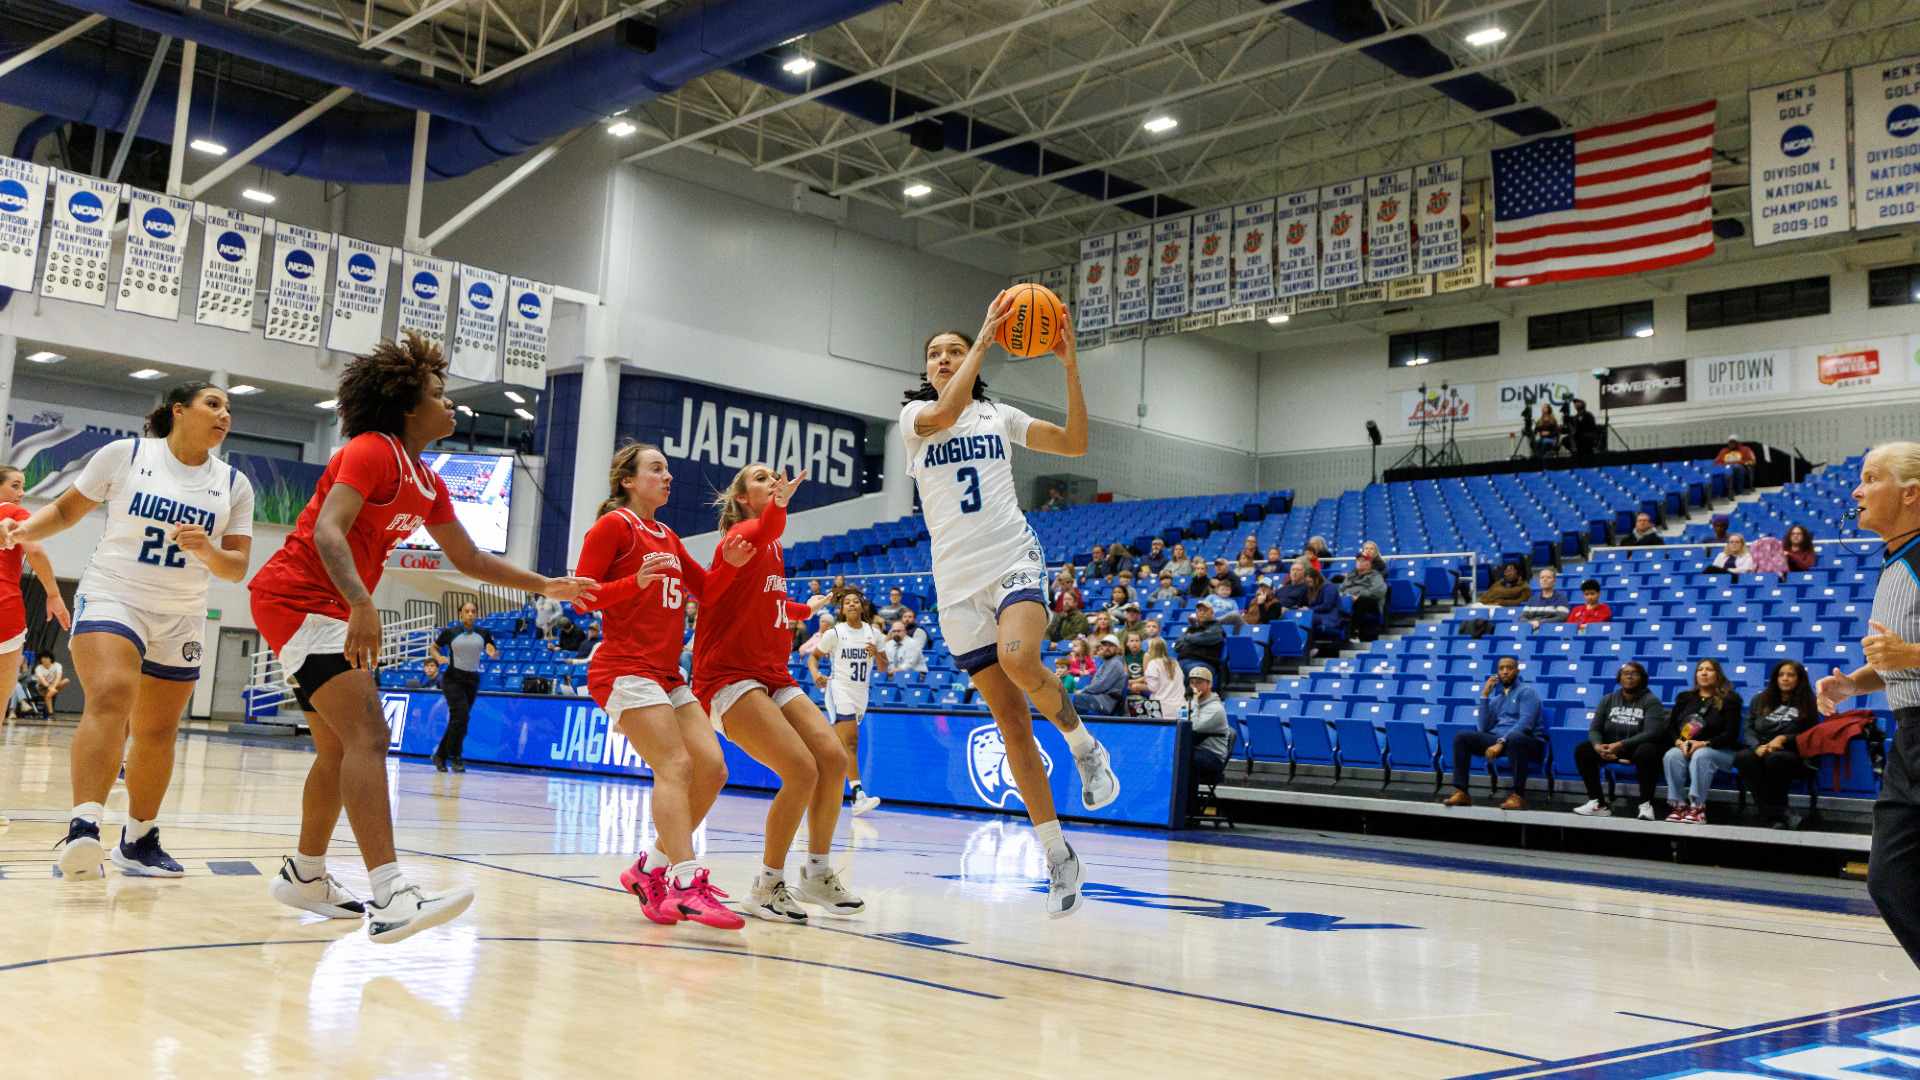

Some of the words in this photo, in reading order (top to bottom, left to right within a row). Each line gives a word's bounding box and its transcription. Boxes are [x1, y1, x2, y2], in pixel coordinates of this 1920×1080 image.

[1777, 84, 1816, 103] MEN'S
[1779, 104, 1814, 121] GOLF
[1428, 163, 1448, 175] MEN'S
[1764, 162, 1819, 182] DIVISION
[1830, 158, 1835, 170] I
[60, 174, 83, 186] MEN'S
[91, 181, 118, 194] TENNIS
[1379, 175, 1398, 186] MEN'S
[1418, 172, 1459, 188] BASKETBALL
[1333, 184, 1352, 195] MEN'S
[1370, 182, 1409, 198] BASKETBALL
[1766, 179, 1831, 200] NATIONAL
[133, 190, 161, 205] WOMEN'S
[170, 198, 191, 211] TENNIS
[1289, 194, 1306, 206] MEN'S
[1763, 196, 1838, 218] CHAMPIONS
[72, 204, 103, 217] NCAA
[228, 209, 244, 221] MEN'S
[1246, 203, 1263, 213] MEN'S
[1, 213, 28, 226] DIVISION
[1205, 213, 1220, 223] MEN'S
[1773, 216, 1828, 234] 2009-10
[54, 219, 69, 231] NCAA
[76, 224, 103, 237] DIVISION
[145, 220, 175, 232] NCAA
[208, 216, 228, 227] CROSS
[234, 222, 260, 235] COUNTRY
[1164, 221, 1179, 231] MEN'S
[1196, 222, 1228, 234] BASKETBALL
[1424, 219, 1454, 232] 2018-19
[55, 230, 109, 249] CHAMPIONSHIP
[290, 227, 318, 240] WOMEN'S
[1370, 235, 1391, 246] PEACH
[1418, 233, 1440, 246] PEACH
[128, 235, 144, 246] NCAA
[150, 240, 175, 253] DIVISION
[277, 233, 296, 244] CROSS
[302, 240, 328, 252] COUNTRY
[349, 240, 381, 255] BASEBALL
[1333, 238, 1350, 250] 2019
[1370, 243, 1408, 256] CONFERENCE
[58, 242, 104, 259] PARTICIPANT
[129, 246, 181, 264] CHAMPIONSHIP
[219, 243, 246, 257] NCAA
[132, 257, 176, 274] PARTICIPANT
[210, 260, 239, 275] DIVISION
[287, 261, 314, 274] NCAA
[349, 265, 376, 278] NCAA
[413, 259, 443, 272] SOFTBALL
[1324, 261, 1358, 275] CONFERENCE
[205, 270, 254, 286] CHAMPIONSHIP
[466, 268, 501, 283] VOLLEYBALL
[1324, 273, 1359, 286] CHAMPIONS
[206, 281, 251, 296] PARTICIPANT
[280, 279, 307, 292] DIVISION
[355, 283, 376, 295] DIVISION
[414, 283, 439, 293] NCAA
[512, 280, 534, 291] WOMEN'S
[539, 283, 553, 295] GOLF
[1196, 282, 1226, 295] CONFERENCE
[1444, 277, 1475, 289] CHAMPIONS
[275, 287, 320, 303] CHAMPIONSHIP
[471, 294, 493, 304] NCAA
[1348, 289, 1383, 301] CHAMPIONS
[276, 298, 317, 312] PARTICIPANT
[402, 297, 415, 307] NCAA
[419, 300, 440, 311] DIVISION
[520, 304, 541, 315] NCAA
[1299, 296, 1334, 309] CHAMPIONS
[404, 306, 445, 321] CHAMPIONSHIP
[474, 312, 494, 322] DIVISION
[1220, 310, 1252, 321] CHAMPIONS
[405, 317, 442, 331] PARTICIPANT
[508, 321, 519, 330] NCAA
[525, 323, 543, 334] DIVISION
[1011, 304, 1028, 350] Wilson
[1040, 316, 1049, 344] EVO
[510, 330, 546, 343] CHAMPIONSHIP
[509, 338, 546, 352] APPEARANCES
[1709, 355, 1773, 383] UPTOWN
[1602, 377, 1684, 394] POWERADE
[1709, 381, 1773, 396] CHEAPSKATE
[663, 397, 855, 488] JAGUARS
[924, 434, 1006, 468] AUGUSTA
[957, 466, 982, 514] 3
[128, 491, 216, 536] AUGUSTA
[138, 526, 186, 568] 22
[400, 554, 440, 569] Coke
[662, 576, 682, 610] 15
[850, 662, 867, 682] 30
[551, 706, 652, 769] JAGNA
